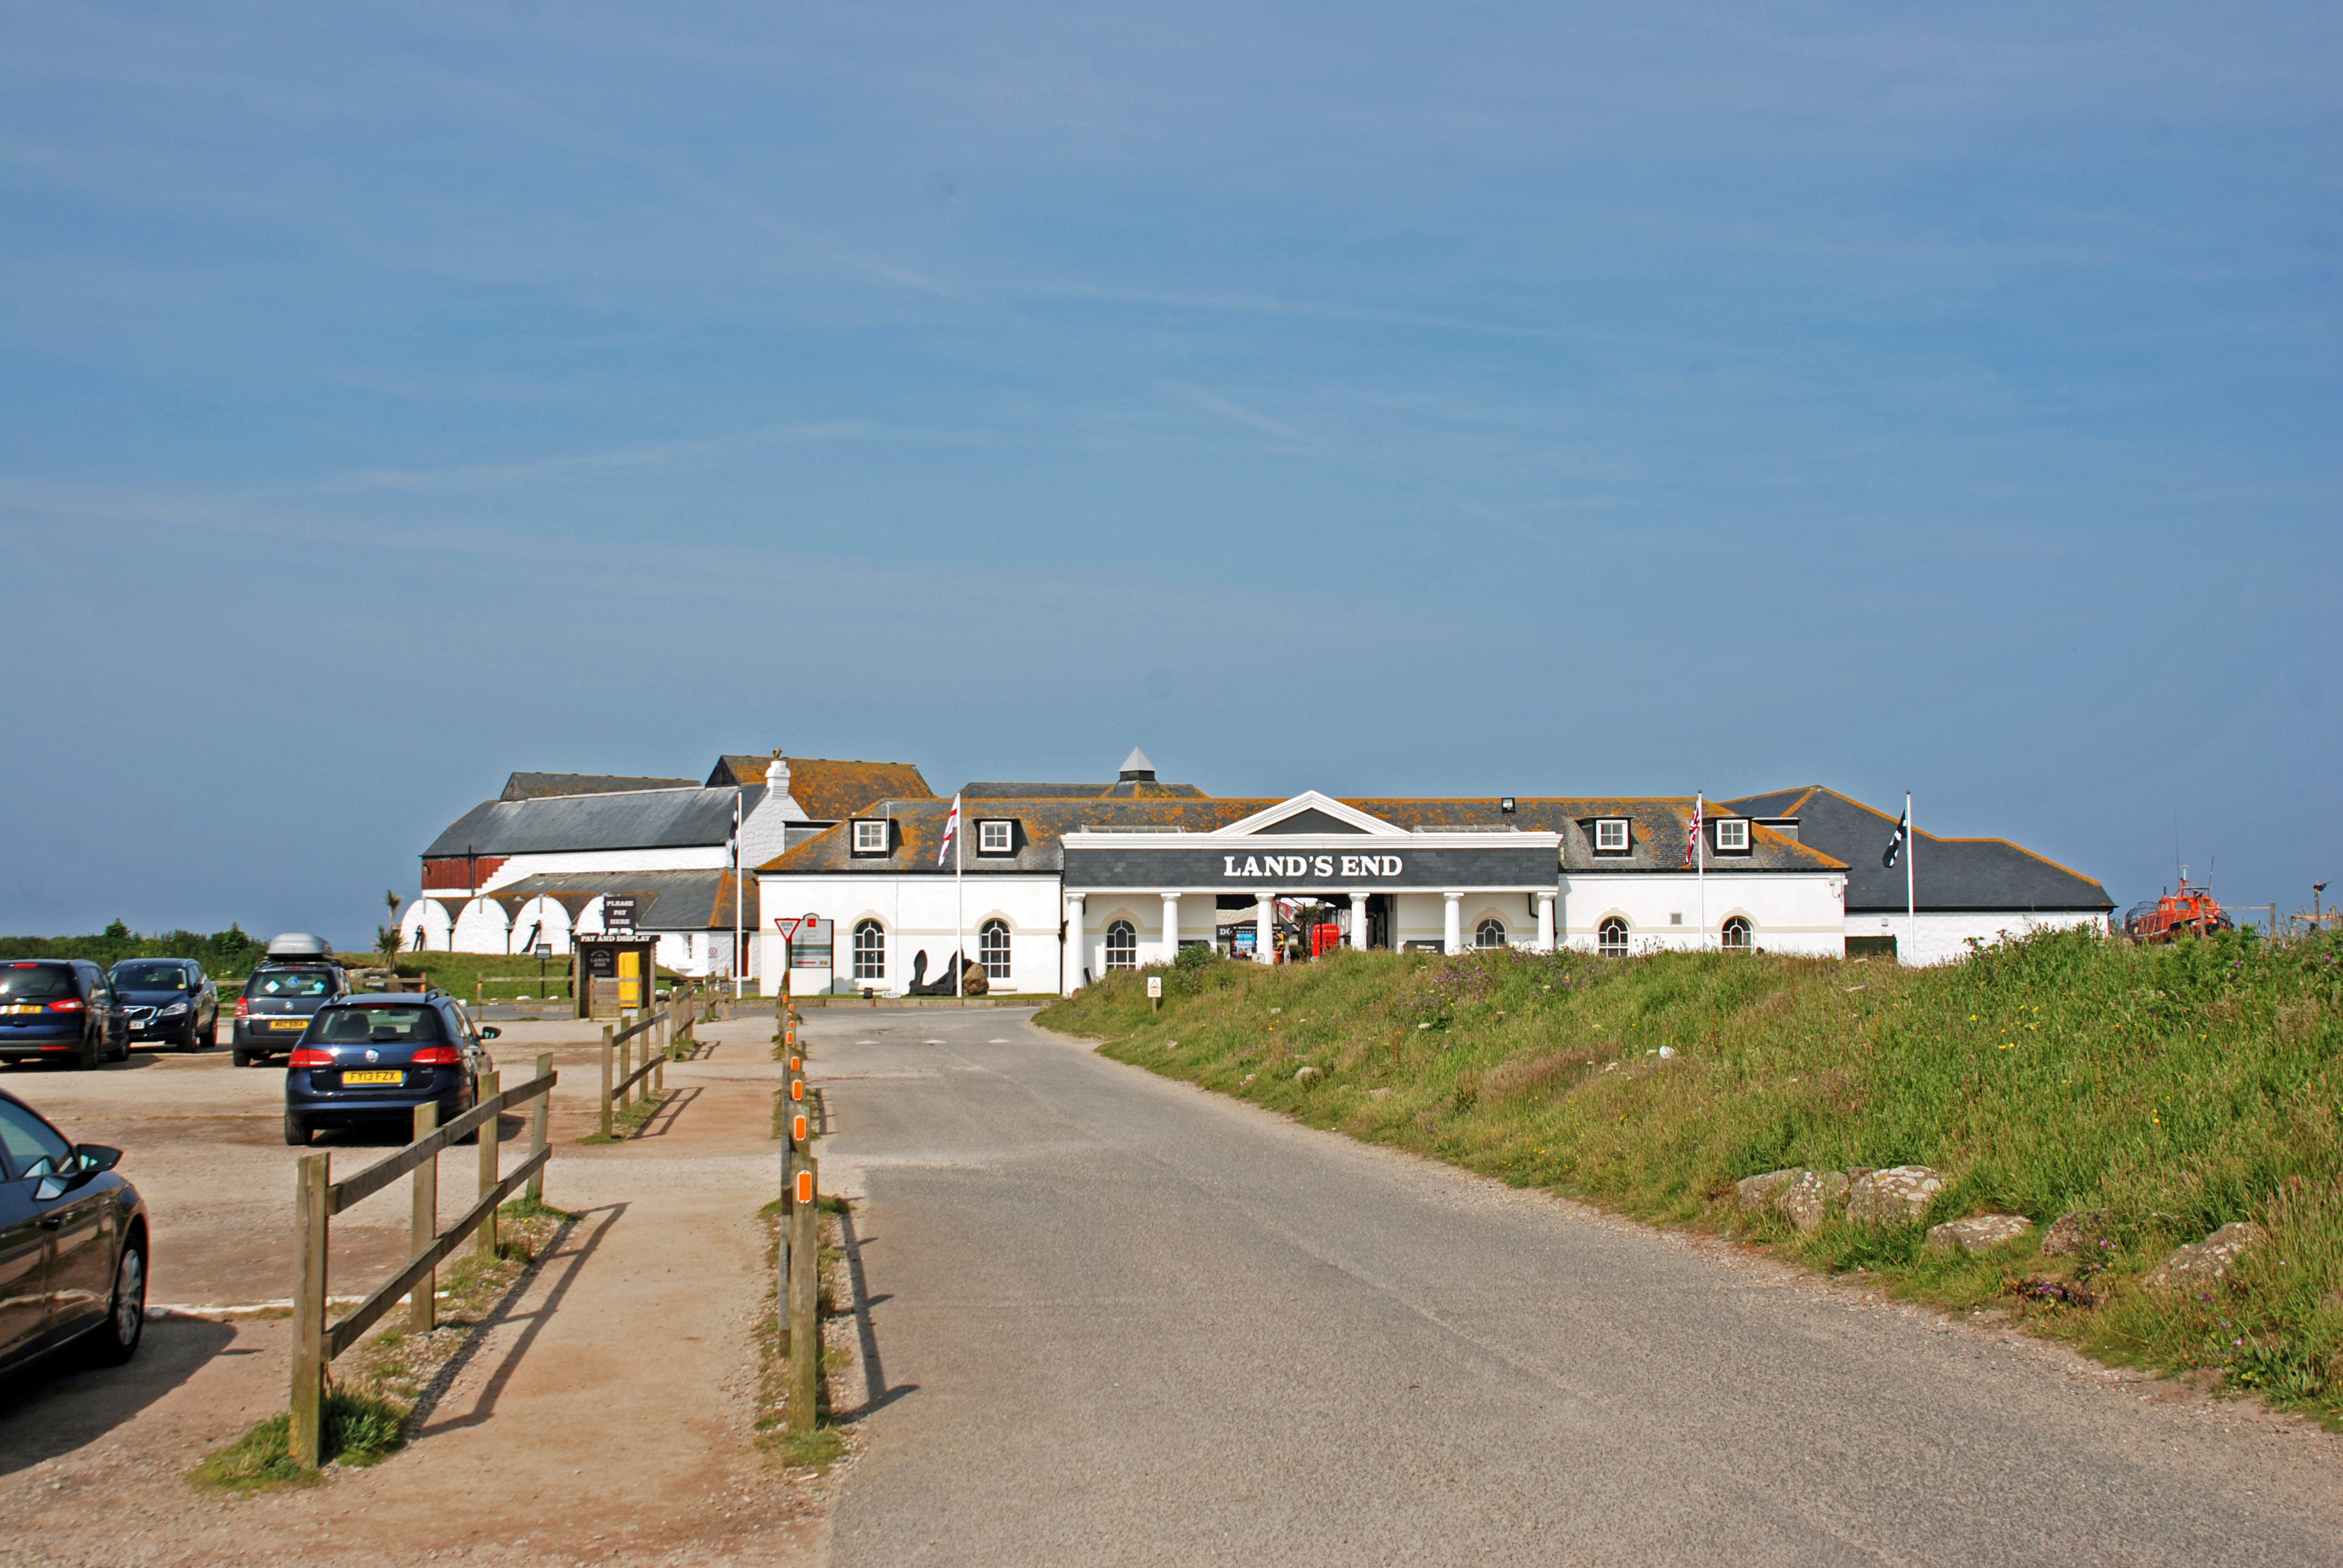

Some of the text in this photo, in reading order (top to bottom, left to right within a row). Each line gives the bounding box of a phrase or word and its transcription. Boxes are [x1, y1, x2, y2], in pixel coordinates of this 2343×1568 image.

[1224, 856, 1403, 877] LAND'S END
[350, 1073, 372, 1081] FY13
